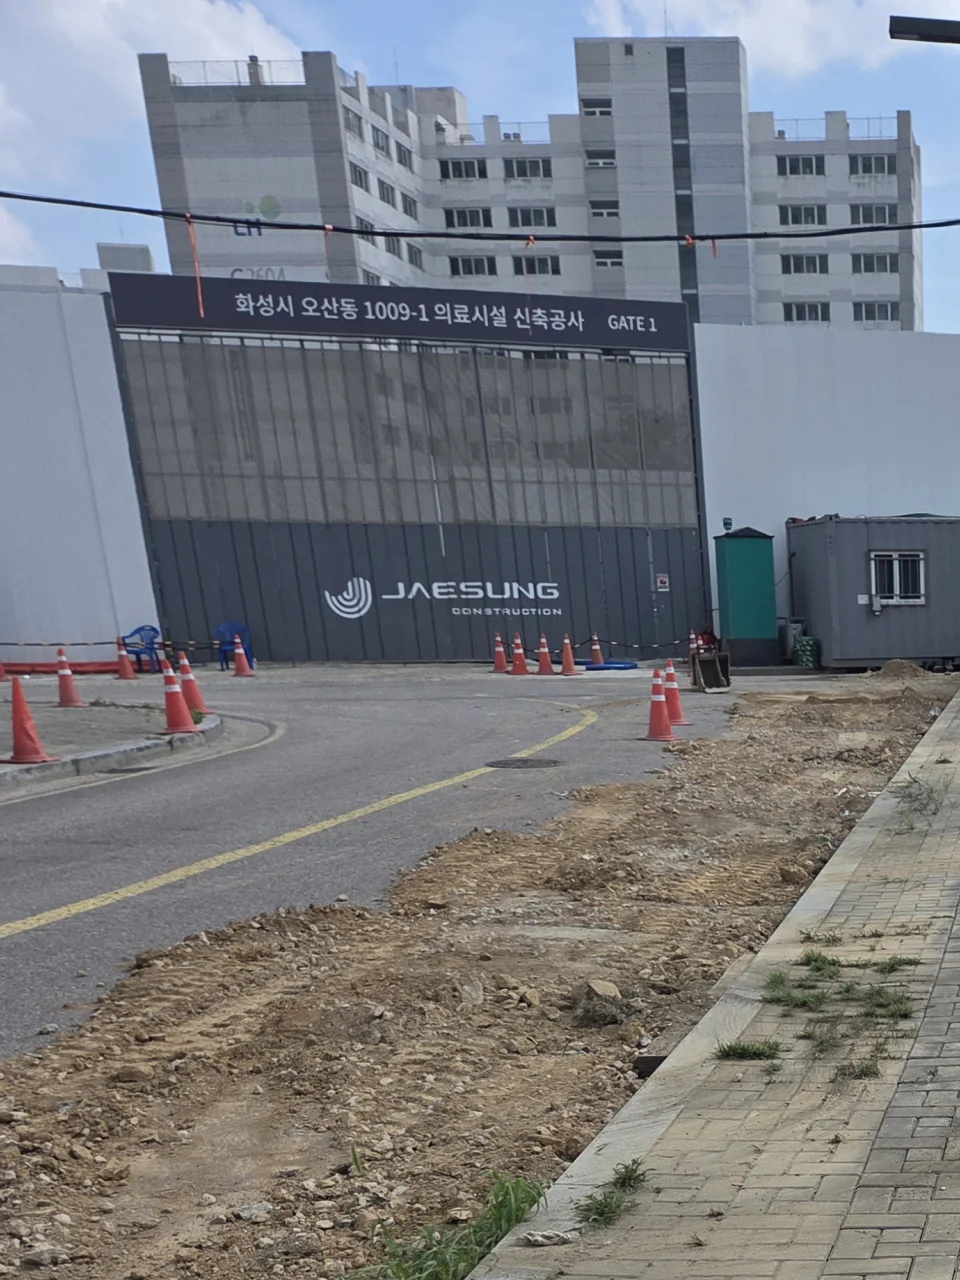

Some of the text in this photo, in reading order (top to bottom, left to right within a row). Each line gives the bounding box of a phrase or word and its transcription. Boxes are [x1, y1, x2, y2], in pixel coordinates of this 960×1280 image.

[234, 293, 658, 332] 화성시 오산동 1009-1 의료시설 신축공사 GATE 1
[381, 581, 560, 600] JAESUNG
[451, 607, 563, 616] CONSTRUCTION
